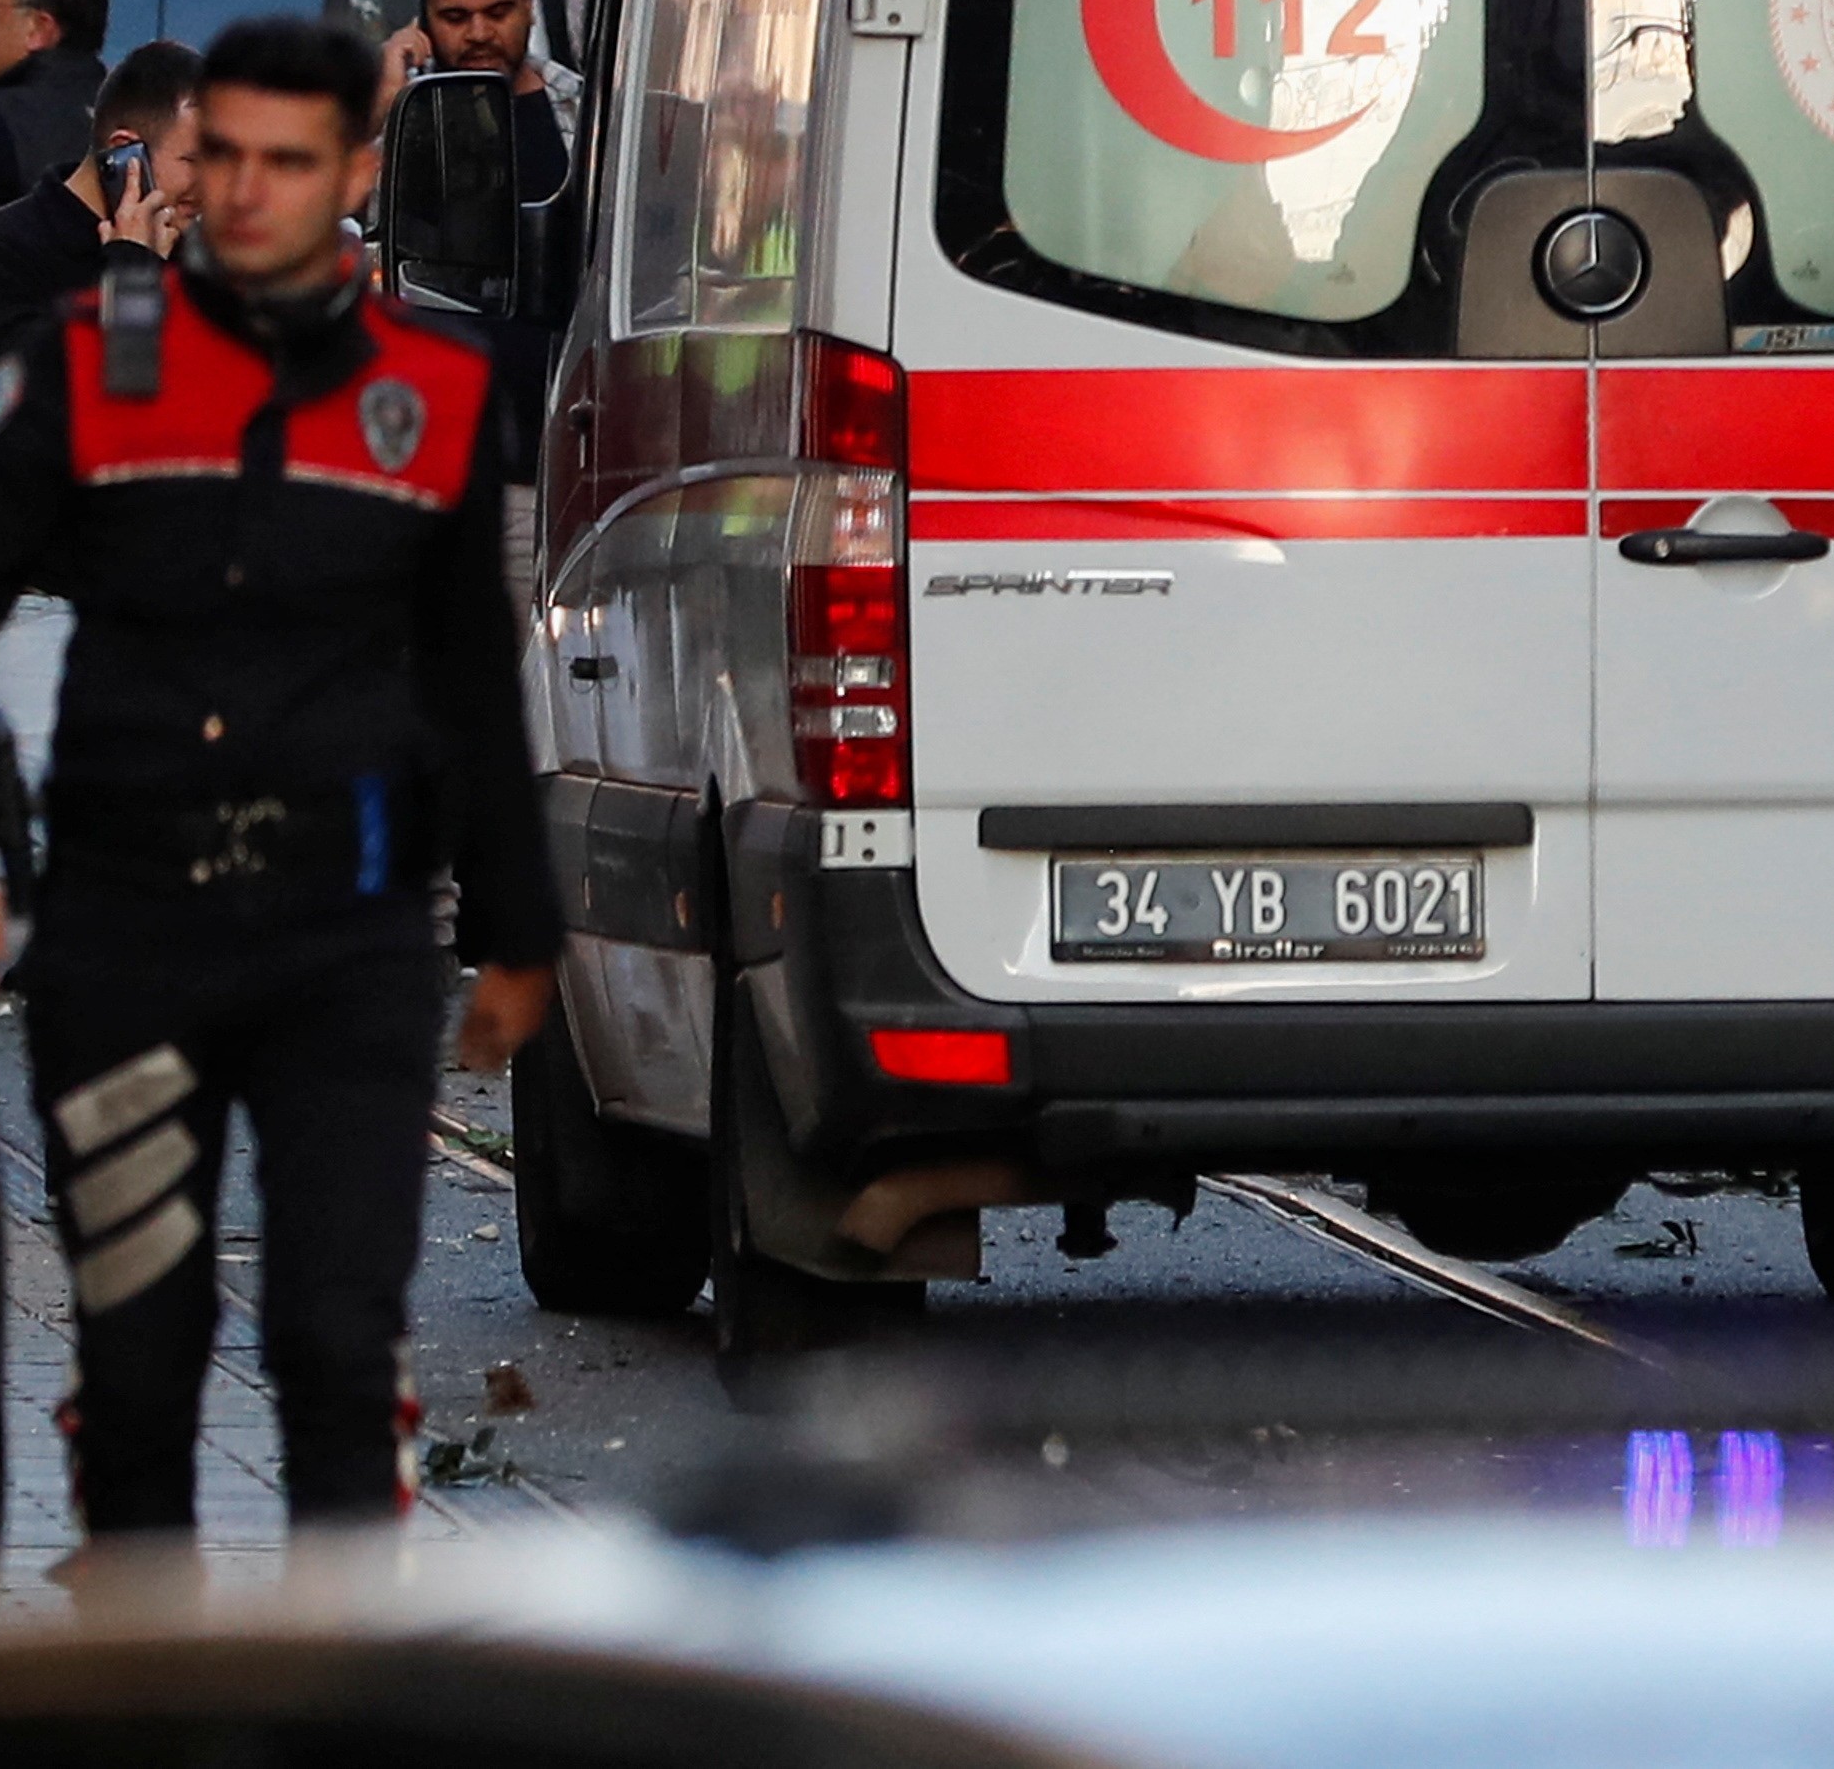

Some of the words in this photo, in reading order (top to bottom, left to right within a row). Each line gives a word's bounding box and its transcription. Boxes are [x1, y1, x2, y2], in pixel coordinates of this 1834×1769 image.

[923, 568, 1175, 597] SPRINTER
[1095, 869, 1169, 938] 34
[1209, 869, 1288, 936] YB
[1334, 869, 1474, 937] 6021
